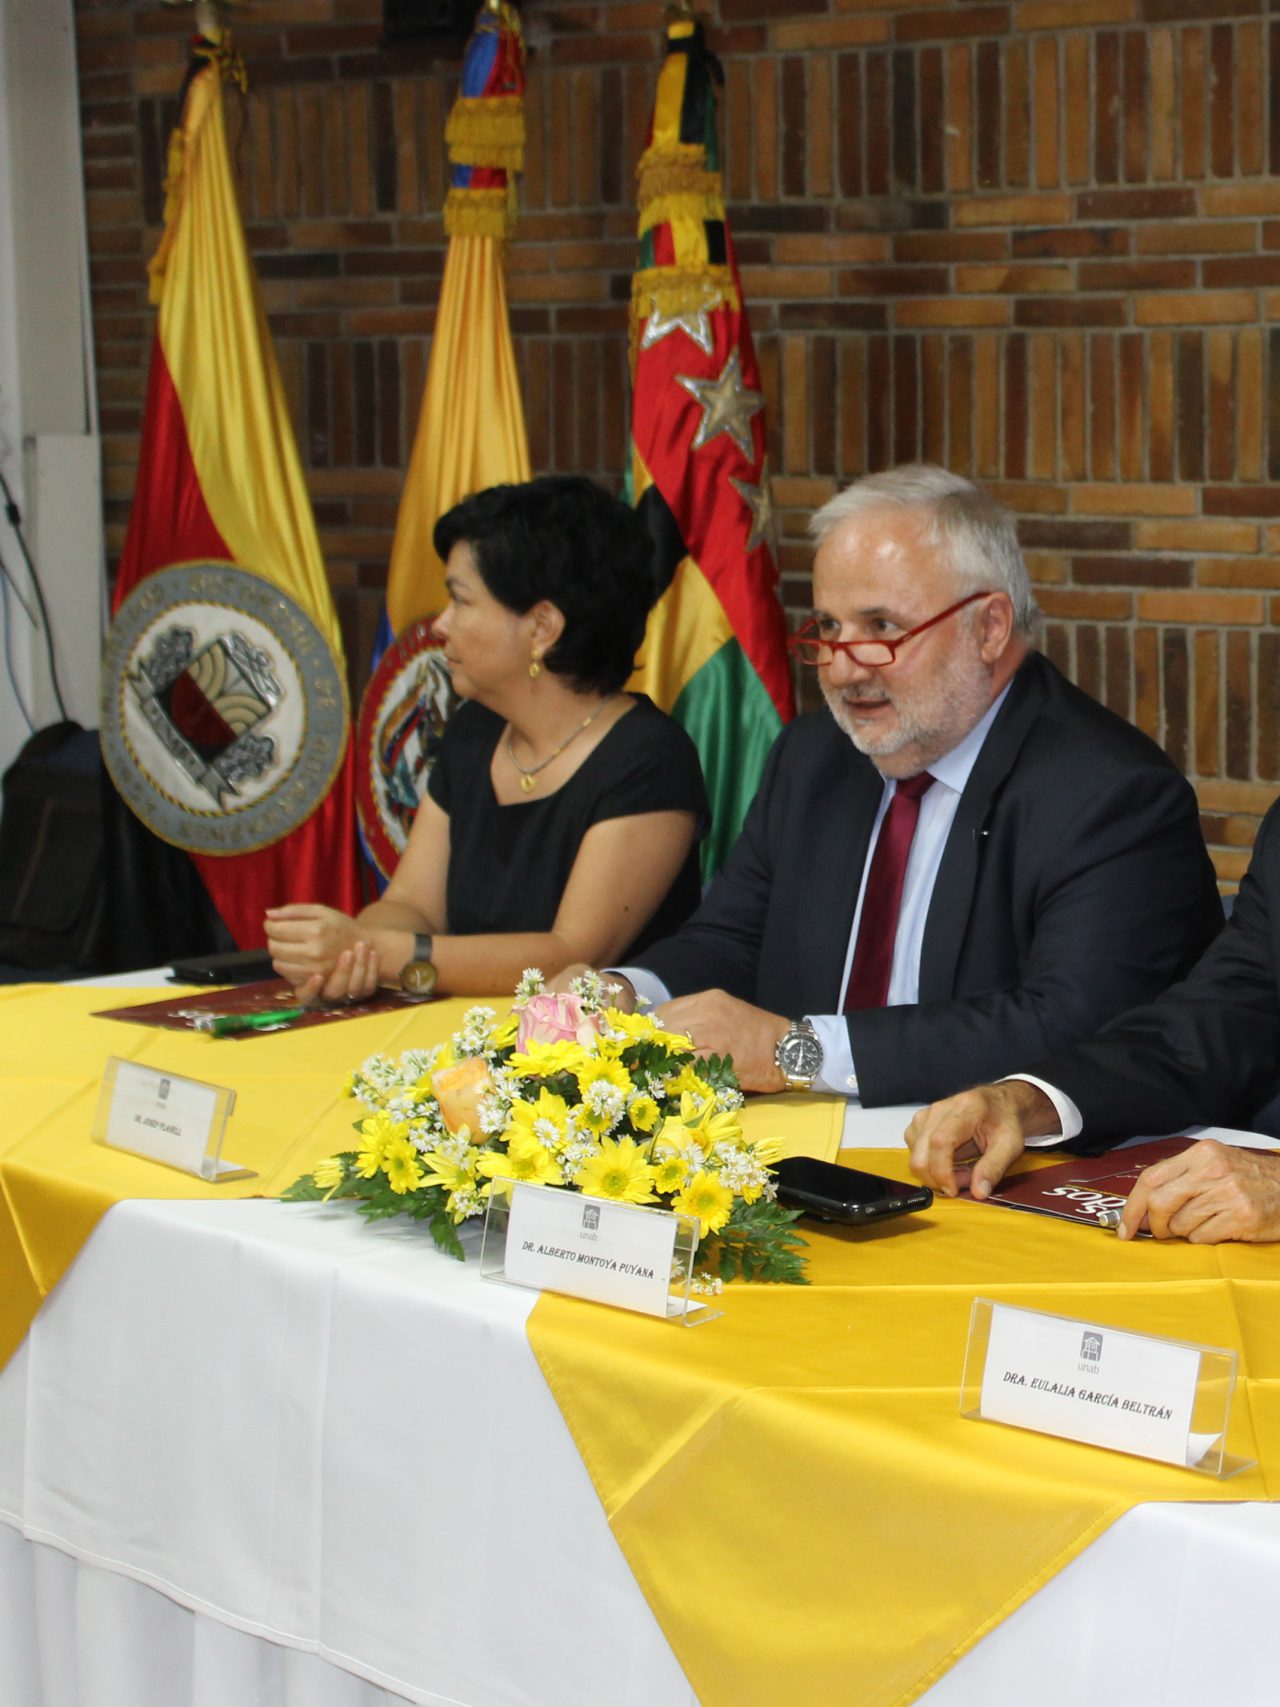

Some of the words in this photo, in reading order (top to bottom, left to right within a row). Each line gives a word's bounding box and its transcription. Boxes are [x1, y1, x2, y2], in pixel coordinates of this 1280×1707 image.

[522, 1241, 536, 1253] DR.
[536, 1244, 577, 1262] ALBERTO
[577, 1254, 617, 1271] MONTOYA
[618, 1263, 655, 1280] PUYANA
[1077, 1362, 1100, 1375] unab
[1003, 1371, 1028, 1387] DRA.
[1029, 1377, 1076, 1398] EULALIA
[1078, 1389, 1119, 1409] GARCÍA
[1121, 1398, 1173, 1420] BELTRÁN
